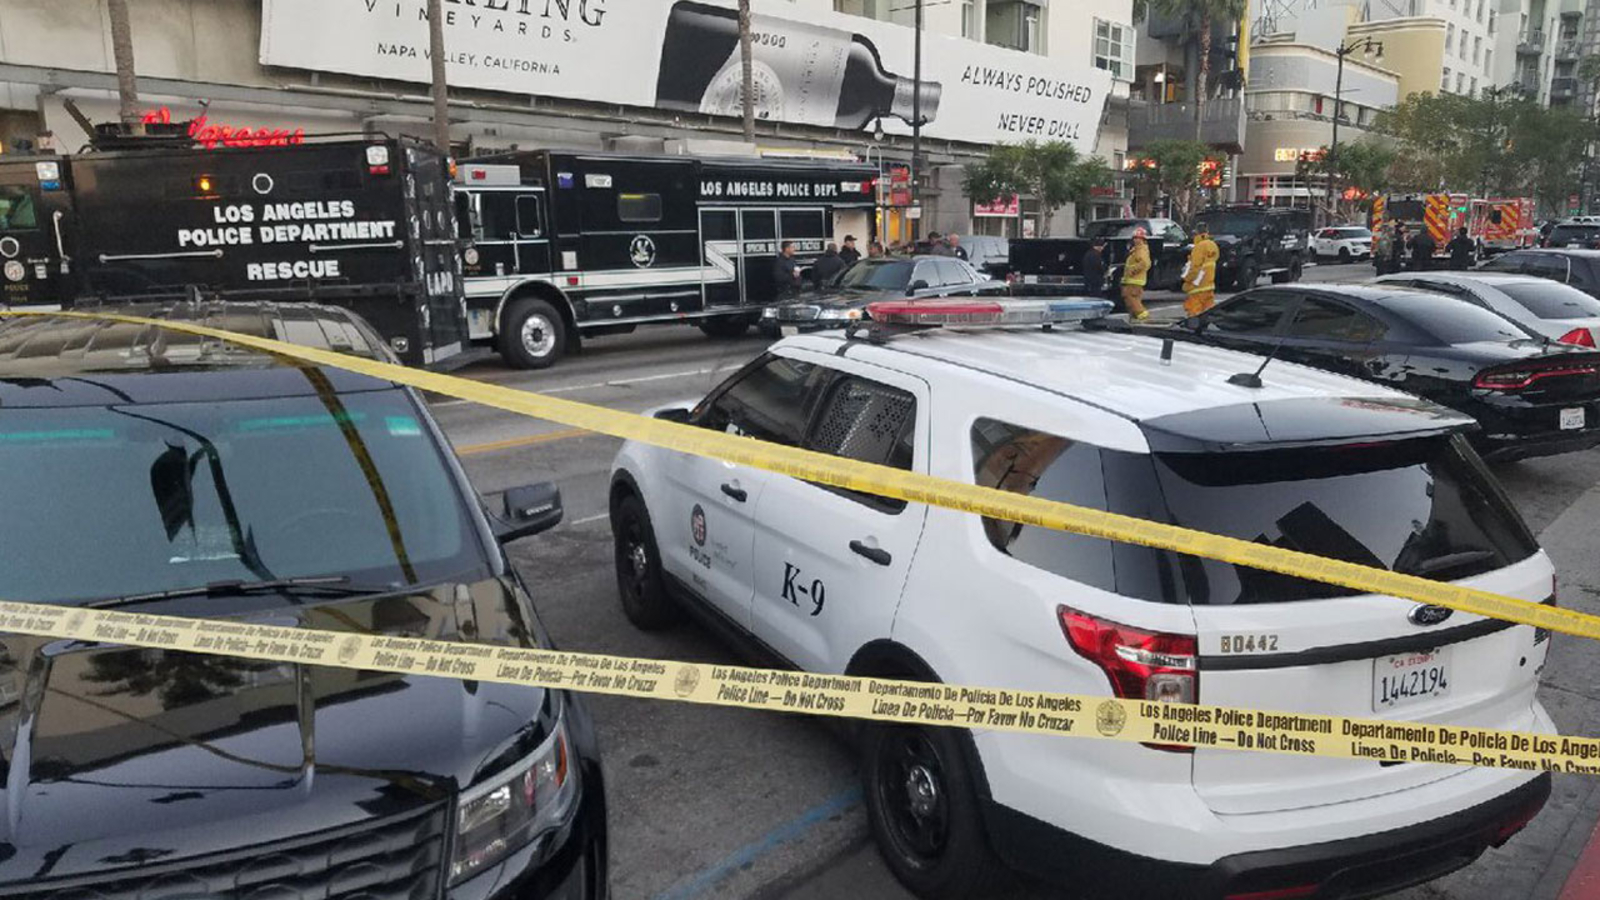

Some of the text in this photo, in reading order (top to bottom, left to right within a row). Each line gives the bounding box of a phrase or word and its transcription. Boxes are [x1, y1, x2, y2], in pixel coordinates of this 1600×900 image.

[364, 0, 572, 42] VINEYARDS
[377, 43, 560, 75] NAPA VLLEY, CALIFORNIA
[961, 65, 1091, 103] ALWAYS POLISHED
[998, 113, 1080, 140] NEVER DULL
[700, 181, 838, 197] LOS ANGELES POLICE DEPT.
[214, 200, 355, 223] LOS ANGELES
[178, 221, 396, 246] POLICE DEPARTMENT
[247, 260, 340, 281] RESCUE
[427, 271, 453, 295] LAPD
[781, 561, 825, 616] K-9
[370, 637, 493, 657] Los Angeles Police Department
[372, 651, 397, 666] Police
[397, 653, 414, 668] Line
[425, 656, 438, 672] Do
[438, 658, 453, 672] Not
[453, 659, 476, 675] Cross
[497, 649, 556, 665] Departamento
[556, 654, 567, 666] De
[600, 657, 613, 670] De
[614, 659, 629, 672] Los
[629, 660, 666, 676] Angeles
[1394, 660, 1405, 668] CA
[520, 665, 533, 681] De
[588, 672, 613, 689] Favor
[613, 675, 626, 689] No
[627, 675, 657, 693] Cruzar
[712, 667, 861, 693] Los Angeles Police Department
[1380, 666, 1447, 703] 1442194
[717, 683, 747, 700] Police
[749, 686, 769, 704] Line
[782, 690, 798, 707] Do
[798, 692, 816, 710] Not
[816, 694, 846, 712] Cross
[869, 679, 1082, 713] Departamento De Policia De Los Angeles
[872, 699, 900, 715] Linea
[902, 702, 918, 718] De
[987, 708, 1017, 727] Favor
[1018, 711, 1035, 728] No
[1036, 712, 1075, 732] Cruzar
[1140, 702, 1333, 735] Los Angeles Police Department
[1153, 722, 1190, 743] Police
[1192, 726, 1217, 745] Line
[1237, 730, 1254, 748] Do
[1256, 732, 1278, 750] Not
[1279, 735, 1316, 754] Cross
[1342, 719, 1436, 745] Departamento
[1439, 727, 1457, 746] De
[1460, 730, 1507, 751] Policia
[1511, 734, 1530, 752] De
[1533, 736, 1557, 755] Los
[1351, 742, 1386, 759] Linea
[1390, 744, 1408, 761] De
[1500, 754, 1537, 771] Favor
[1541, 757, 1563, 773] No
